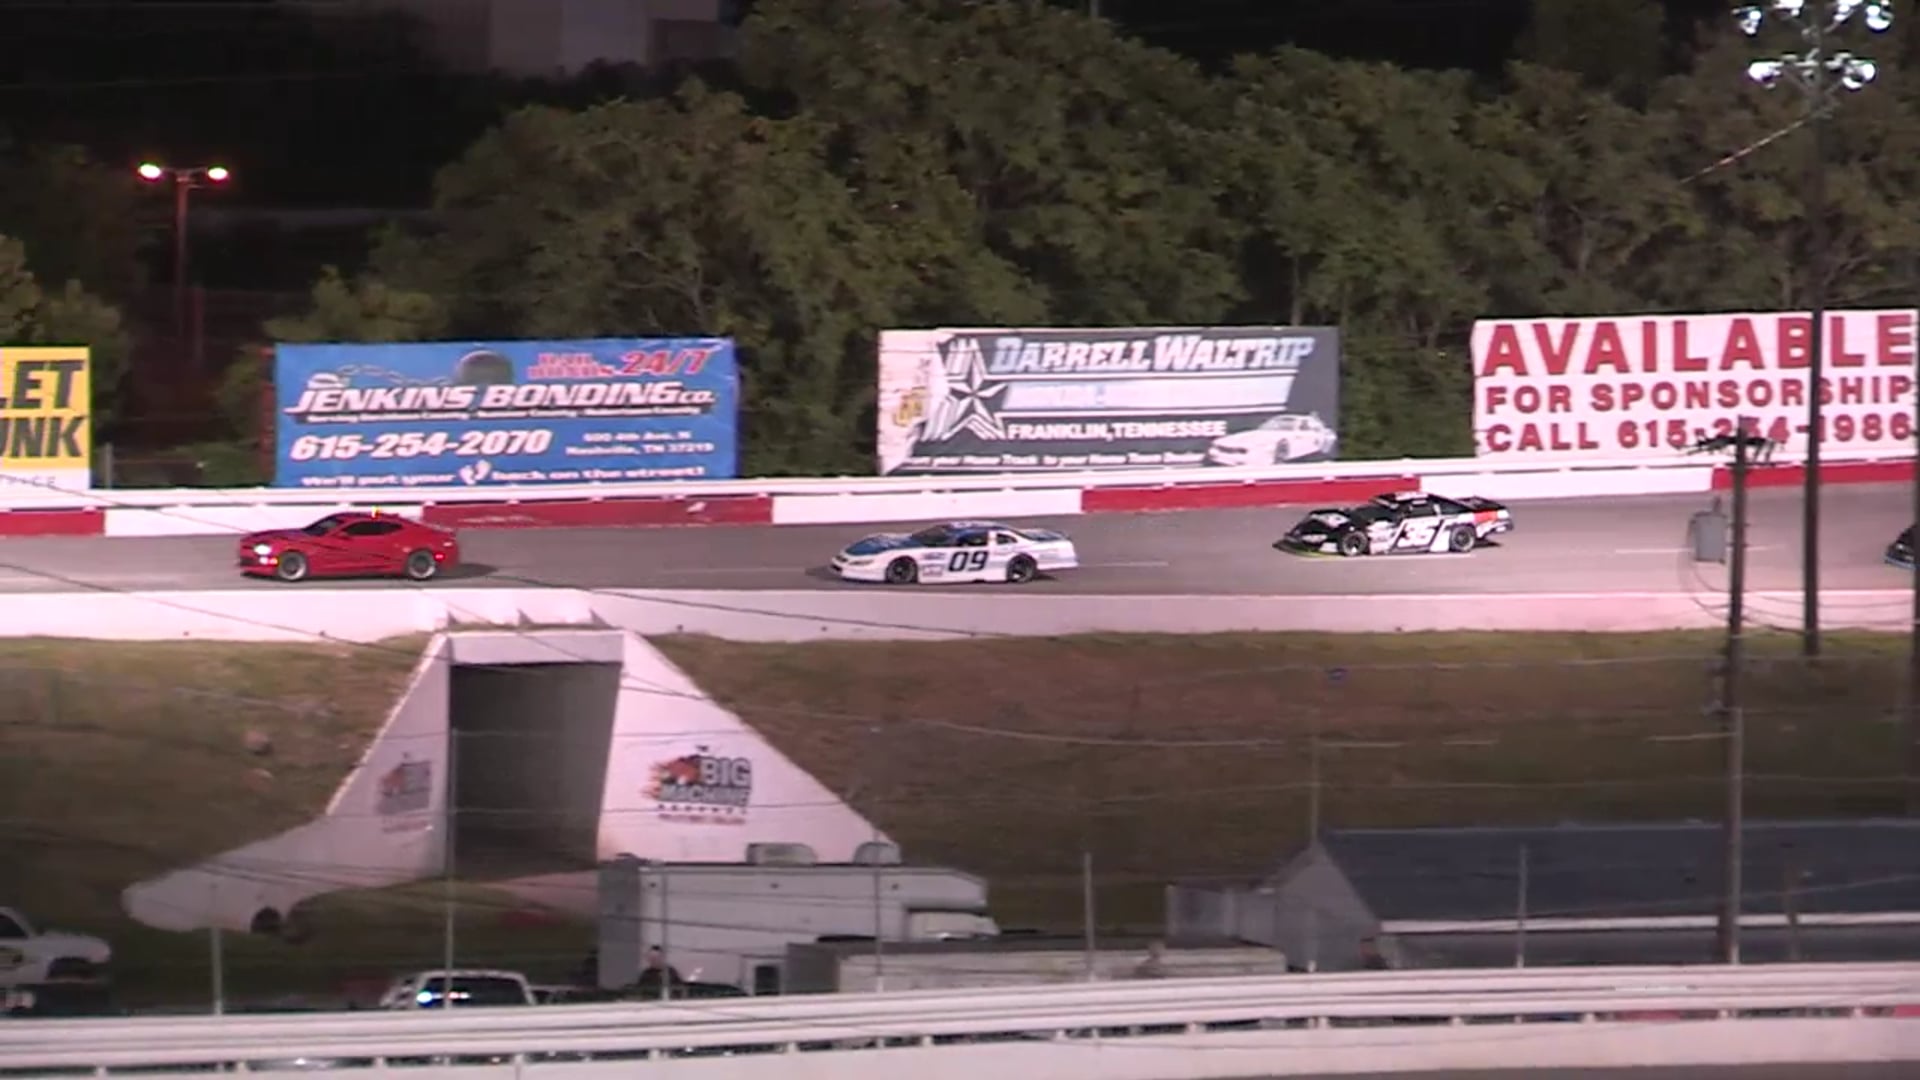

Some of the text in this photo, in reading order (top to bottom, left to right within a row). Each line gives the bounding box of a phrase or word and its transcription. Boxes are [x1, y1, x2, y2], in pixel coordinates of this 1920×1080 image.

[989, 334, 1316, 373] DARRELL WALTRIP
[1482, 313, 1913, 377] AVAILABLE
[620, 349, 714, 375] 24/7
[0, 359, 85, 410] ET
[283, 385, 477, 414] JENKINS
[478, 381, 683, 409] BONDING
[1486, 375, 1912, 415] FOR SPONSORSHIP
[290, 428, 554, 461] 615-254-2070
[1486, 422, 1600, 452] CALL
[1398, 520, 1438, 548] 35
[947, 550, 990, 573] 09
[700, 756, 752, 787] BIG
